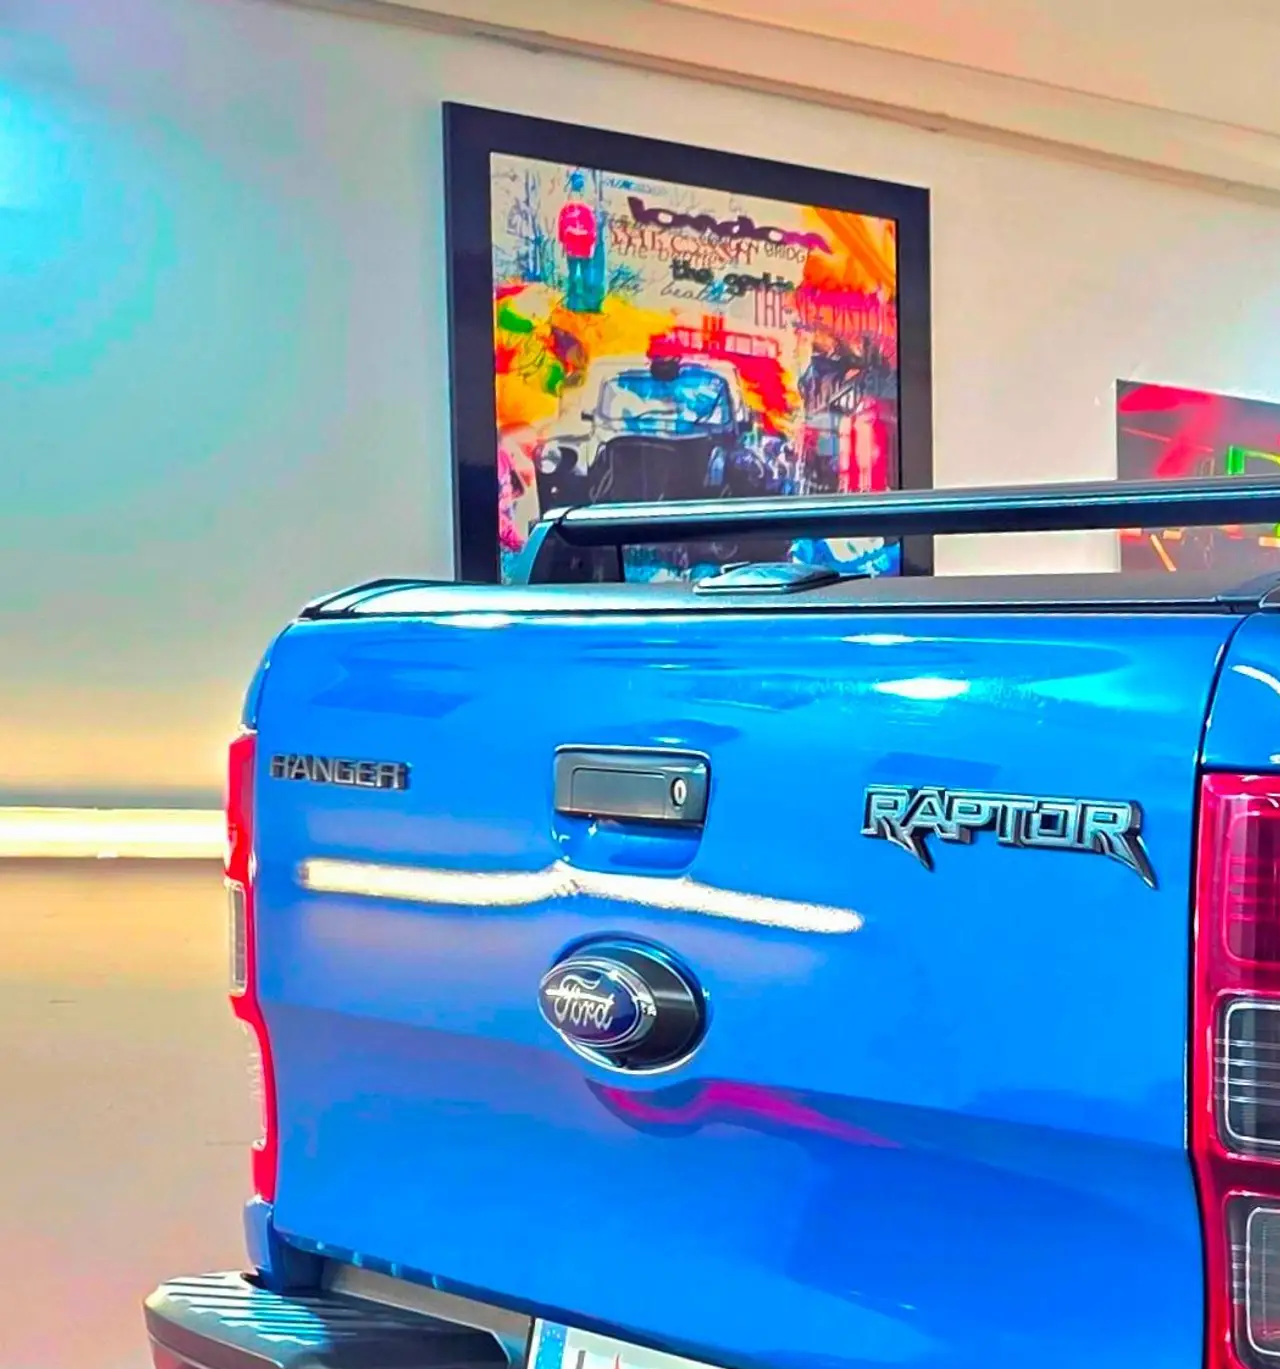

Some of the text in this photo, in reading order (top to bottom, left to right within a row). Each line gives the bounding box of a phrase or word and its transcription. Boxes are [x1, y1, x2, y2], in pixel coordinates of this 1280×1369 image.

[269, 753, 411, 790] RANGER
[860, 785, 1156, 888] RAPTOR
[545, 974, 615, 1030] Ford
